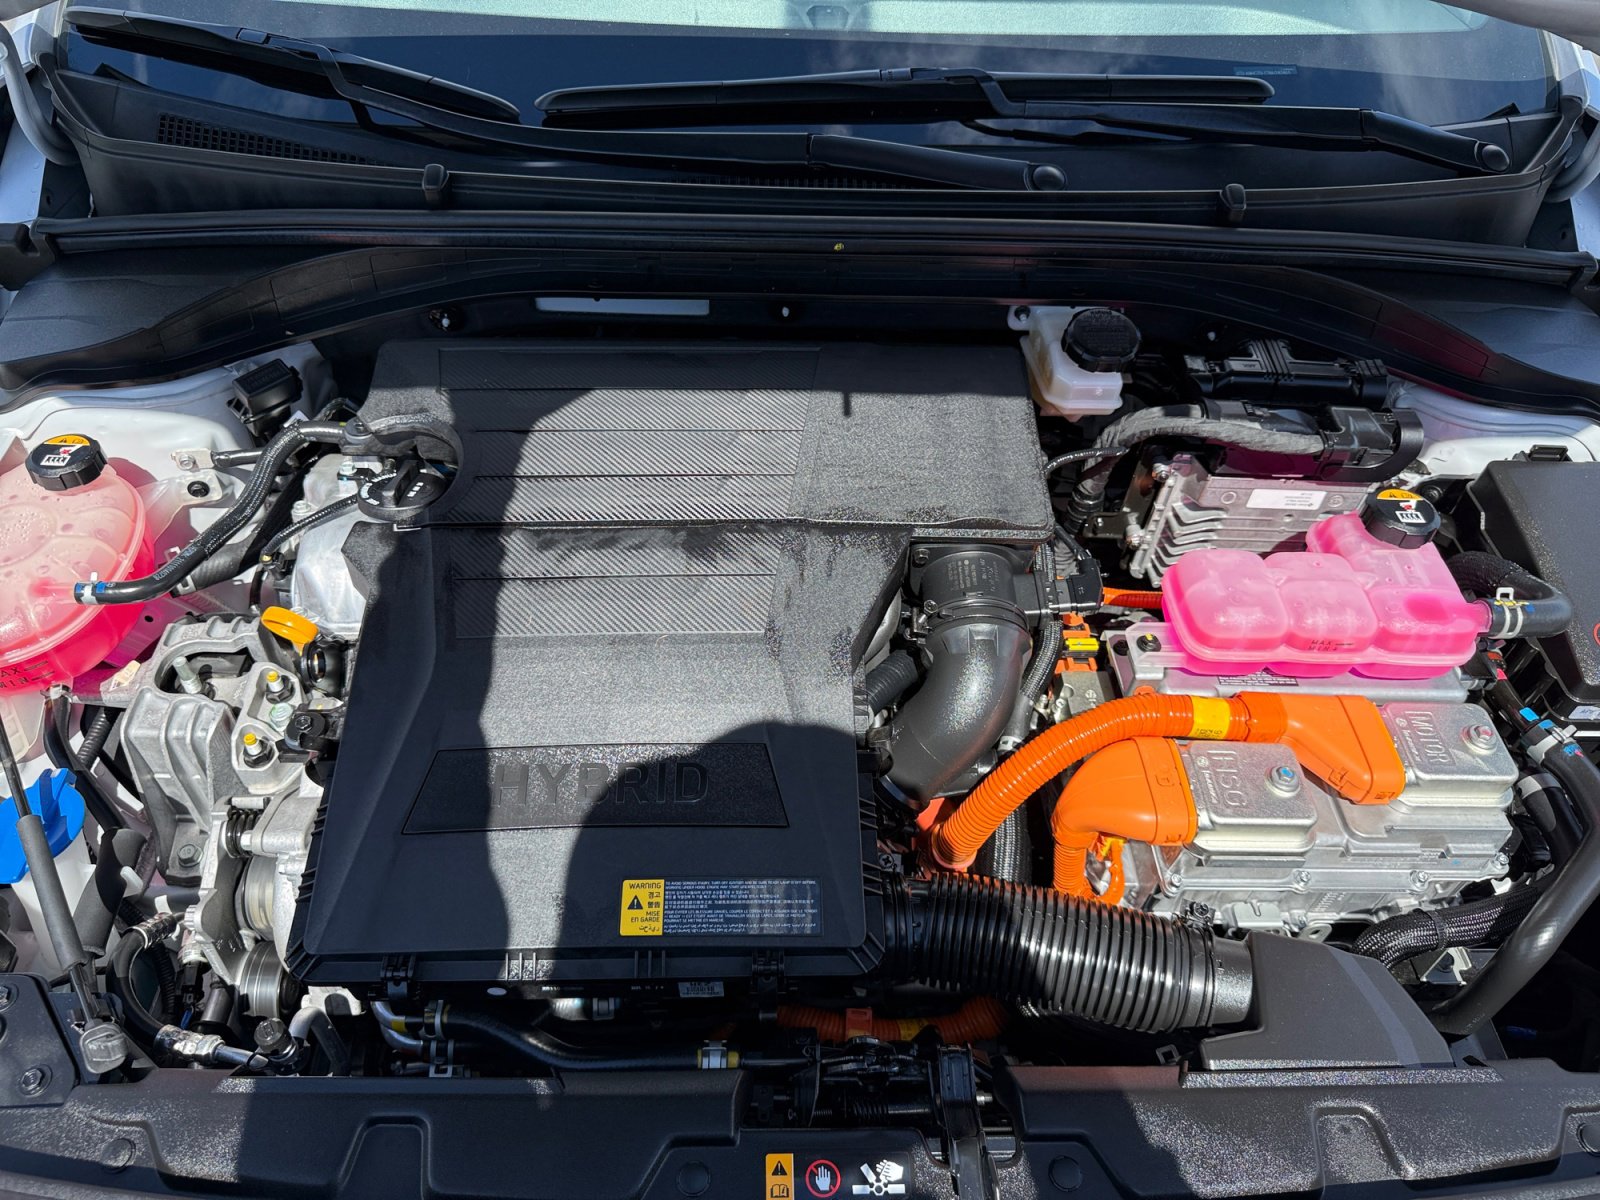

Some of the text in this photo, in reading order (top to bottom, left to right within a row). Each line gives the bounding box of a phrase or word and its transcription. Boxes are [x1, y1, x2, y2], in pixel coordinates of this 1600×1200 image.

[0, 667, 21, 677] AX
[1408, 714, 1449, 765] MOTOR
[494, 760, 709, 804] HYBRID
